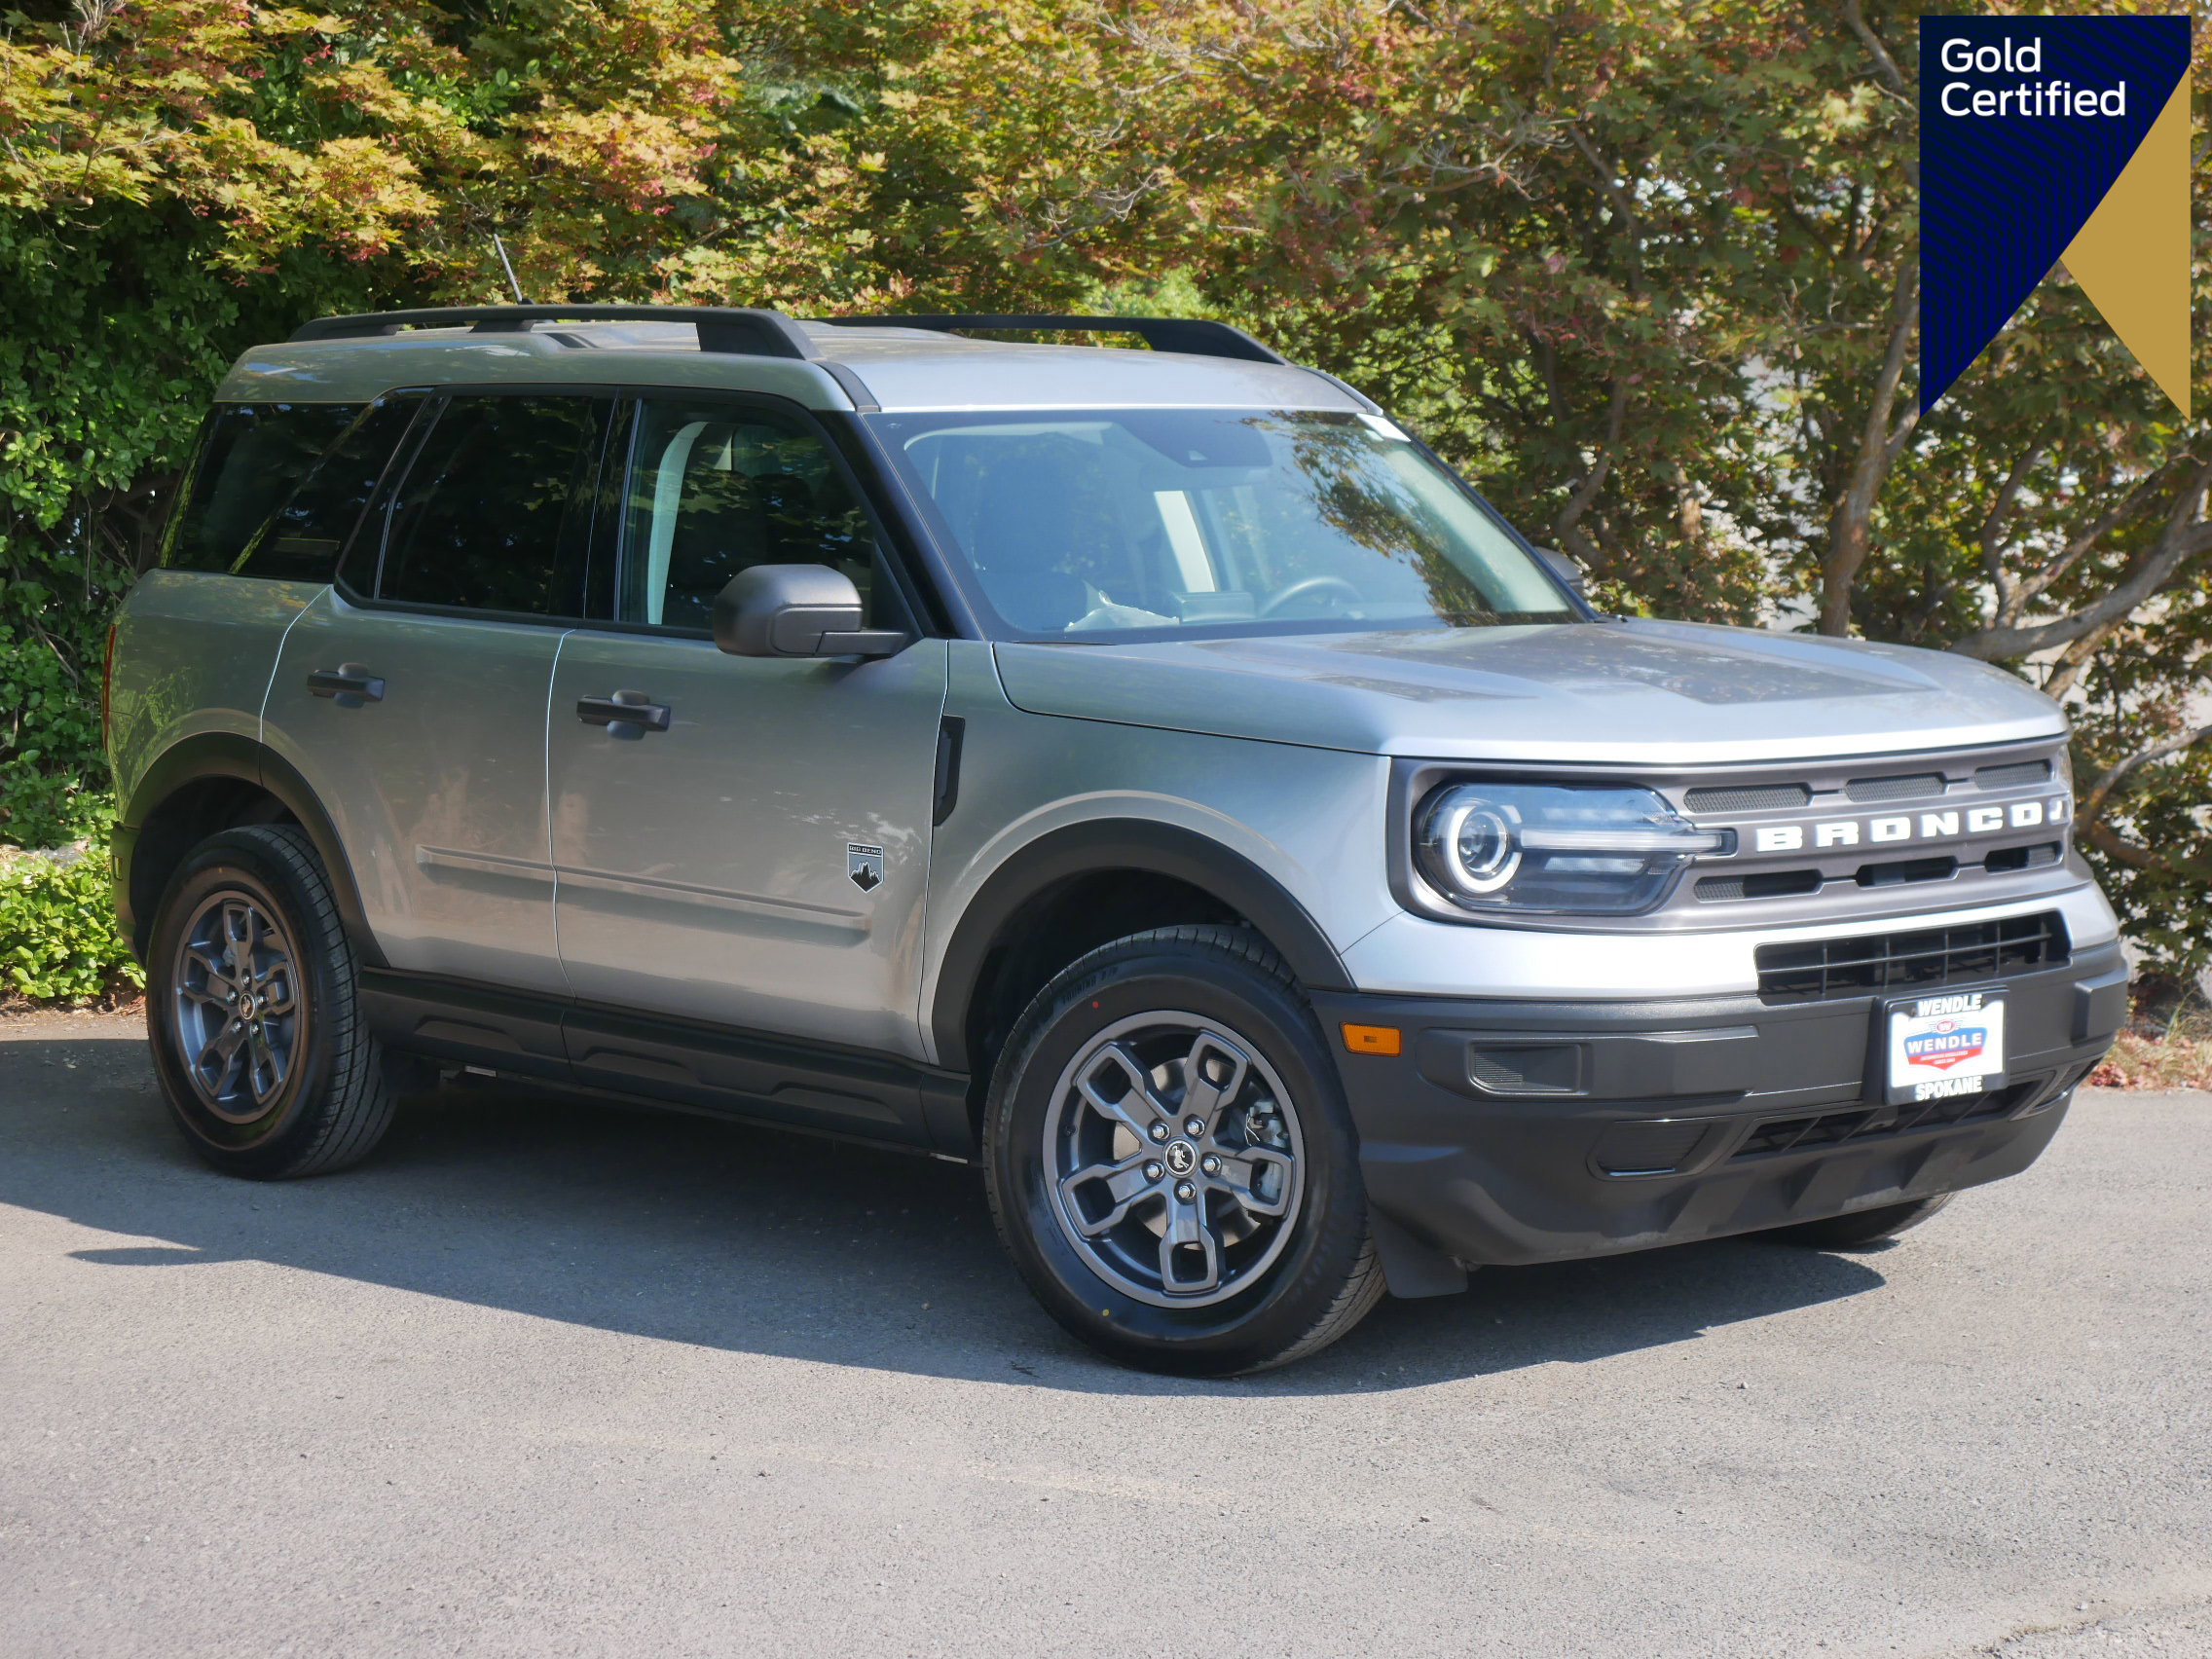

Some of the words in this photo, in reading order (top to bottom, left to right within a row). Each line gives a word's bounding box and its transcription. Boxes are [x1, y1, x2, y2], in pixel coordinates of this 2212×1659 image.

[1756, 801, 2043, 852] BRONCO
[1917, 994, 1982, 1017] WENDLE
[1907, 1032, 1982, 1053] WENDLE
[1915, 1075, 1983, 1101] SPOKANE
